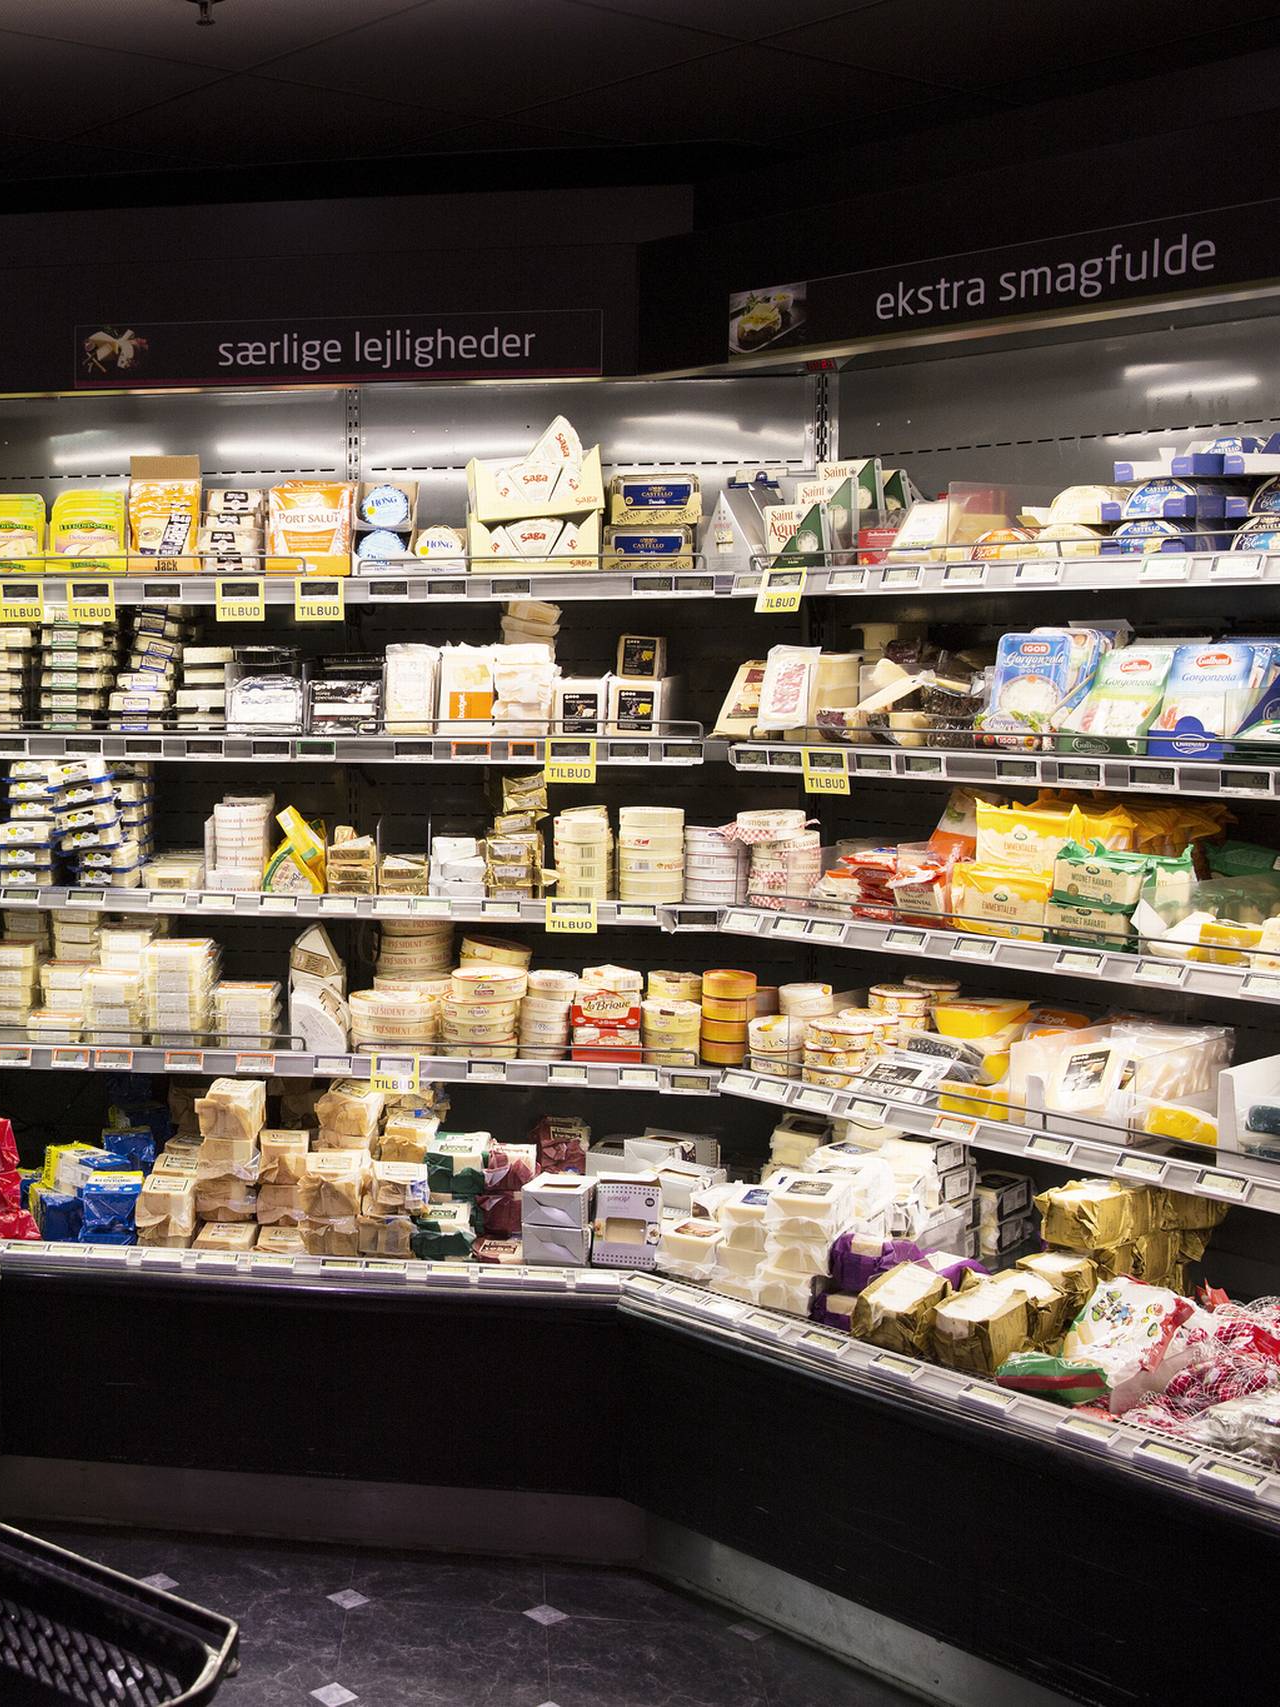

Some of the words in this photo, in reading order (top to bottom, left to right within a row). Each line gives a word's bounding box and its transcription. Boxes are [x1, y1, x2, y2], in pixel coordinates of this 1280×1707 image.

[876, 275, 985, 321] ekstra
[999, 232, 1217, 298] smagfulde
[218, 331, 342, 371] særlige
[354, 326, 536, 370] lejligheder
[824, 467, 848, 480] Saint
[802, 486, 825, 499] Saint
[1145, 486, 1177, 494] CASTELLO
[278, 513, 305, 525] PORT
[308, 511, 340, 523] SALUT
[771, 510, 794, 522] Saint
[59, 522, 114, 531] LEERDAMMER
[769, 523, 801, 543] Agur
[155, 560, 178, 571] Jack
[3, 607, 42, 618] TILBUD
[72, 607, 112, 618] TILBUD
[220, 606, 261, 616] TILBUD
[299, 606, 340, 616] TILBUD
[1023, 645, 1047, 653] IGOR
[1004, 652, 1064, 667] Gorgonzola
[1197, 655, 1231, 666] Galbani
[1120, 662, 1152, 673] Galbani
[1105, 678, 1155, 689] Gorgonzola
[1181, 674, 1237, 684] Gorgonzola
[550, 768, 591, 778] TILBUD
[808, 777, 846, 789] TILBUD
[1071, 872, 1091, 885] MODNET
[982, 901, 1017, 916] EMMENTALER
[550, 920, 593, 930] TILBUD
[1060, 915, 1080, 926] MODNET
[1082, 918, 1107, 929] HAVARTI
